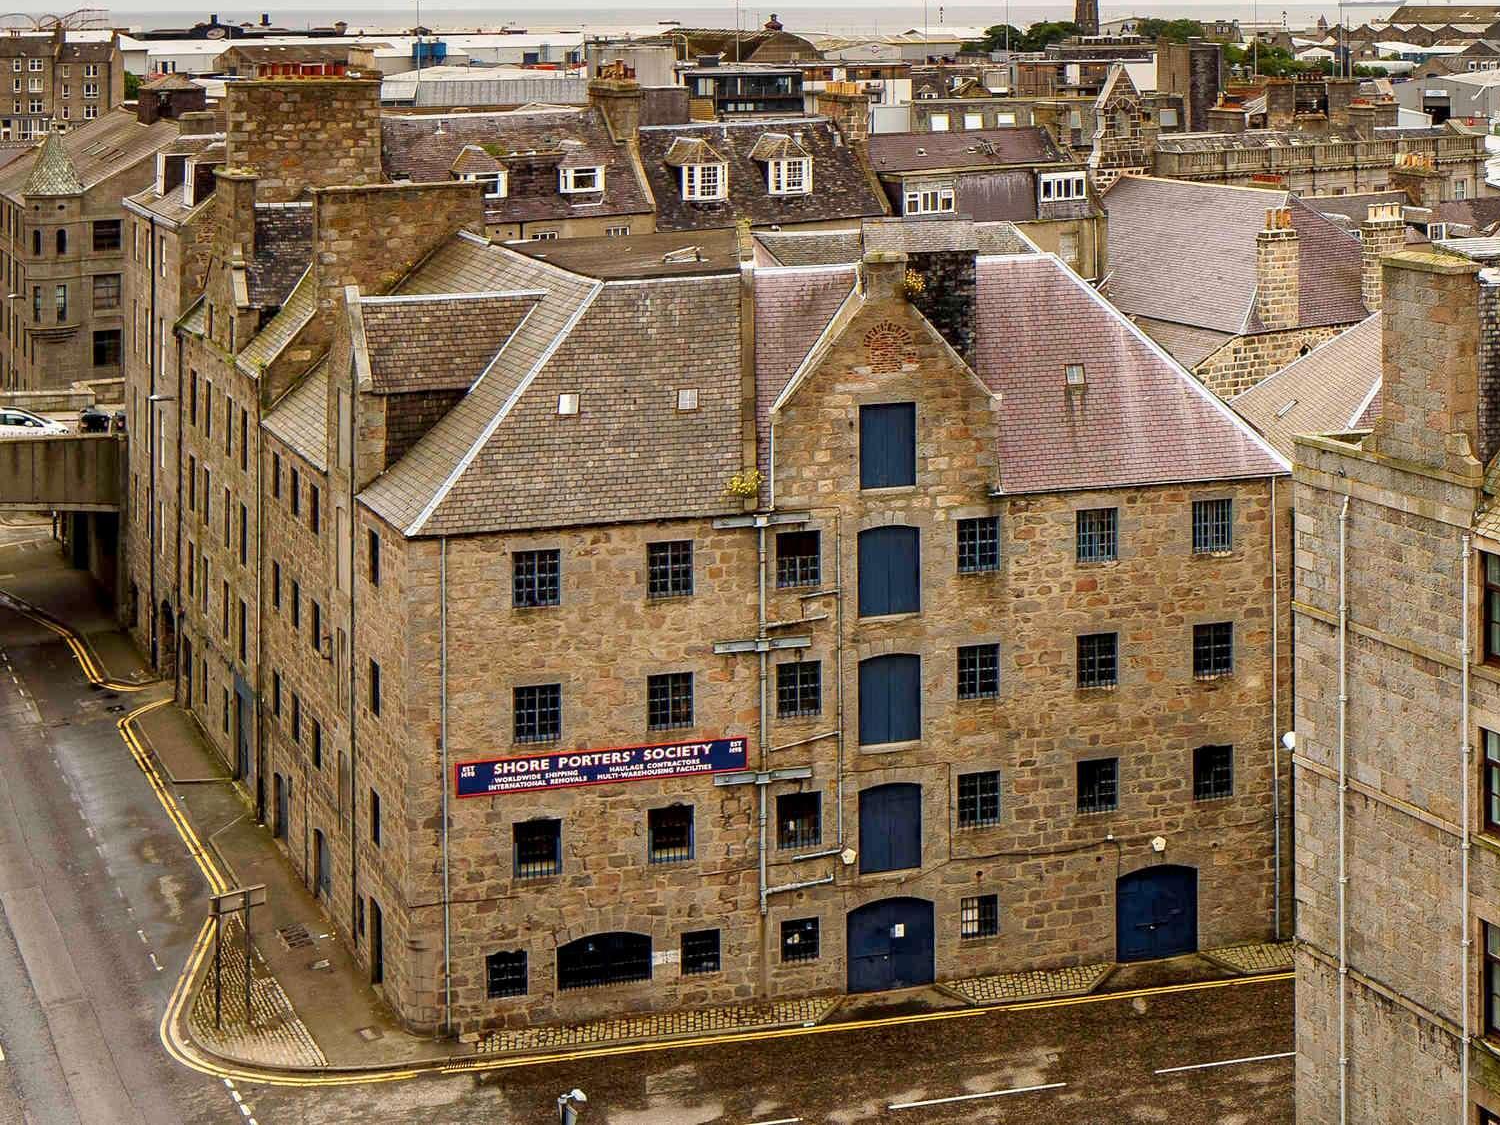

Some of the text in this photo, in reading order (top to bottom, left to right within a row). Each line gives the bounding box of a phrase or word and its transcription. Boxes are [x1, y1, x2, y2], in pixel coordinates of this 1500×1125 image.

[494, 743, 713, 775] SHORE PORTERS' SOCIETY
[609, 758, 701, 773] HAULAGE CONTRACTORS
[494, 770, 579, 783] WORLDWIDE SHIPPING
[597, 763, 713, 780] MULTI-WAREHOUSING FACILITIES
[488, 775, 588, 791] INTERNATIONAL REMOVALS
